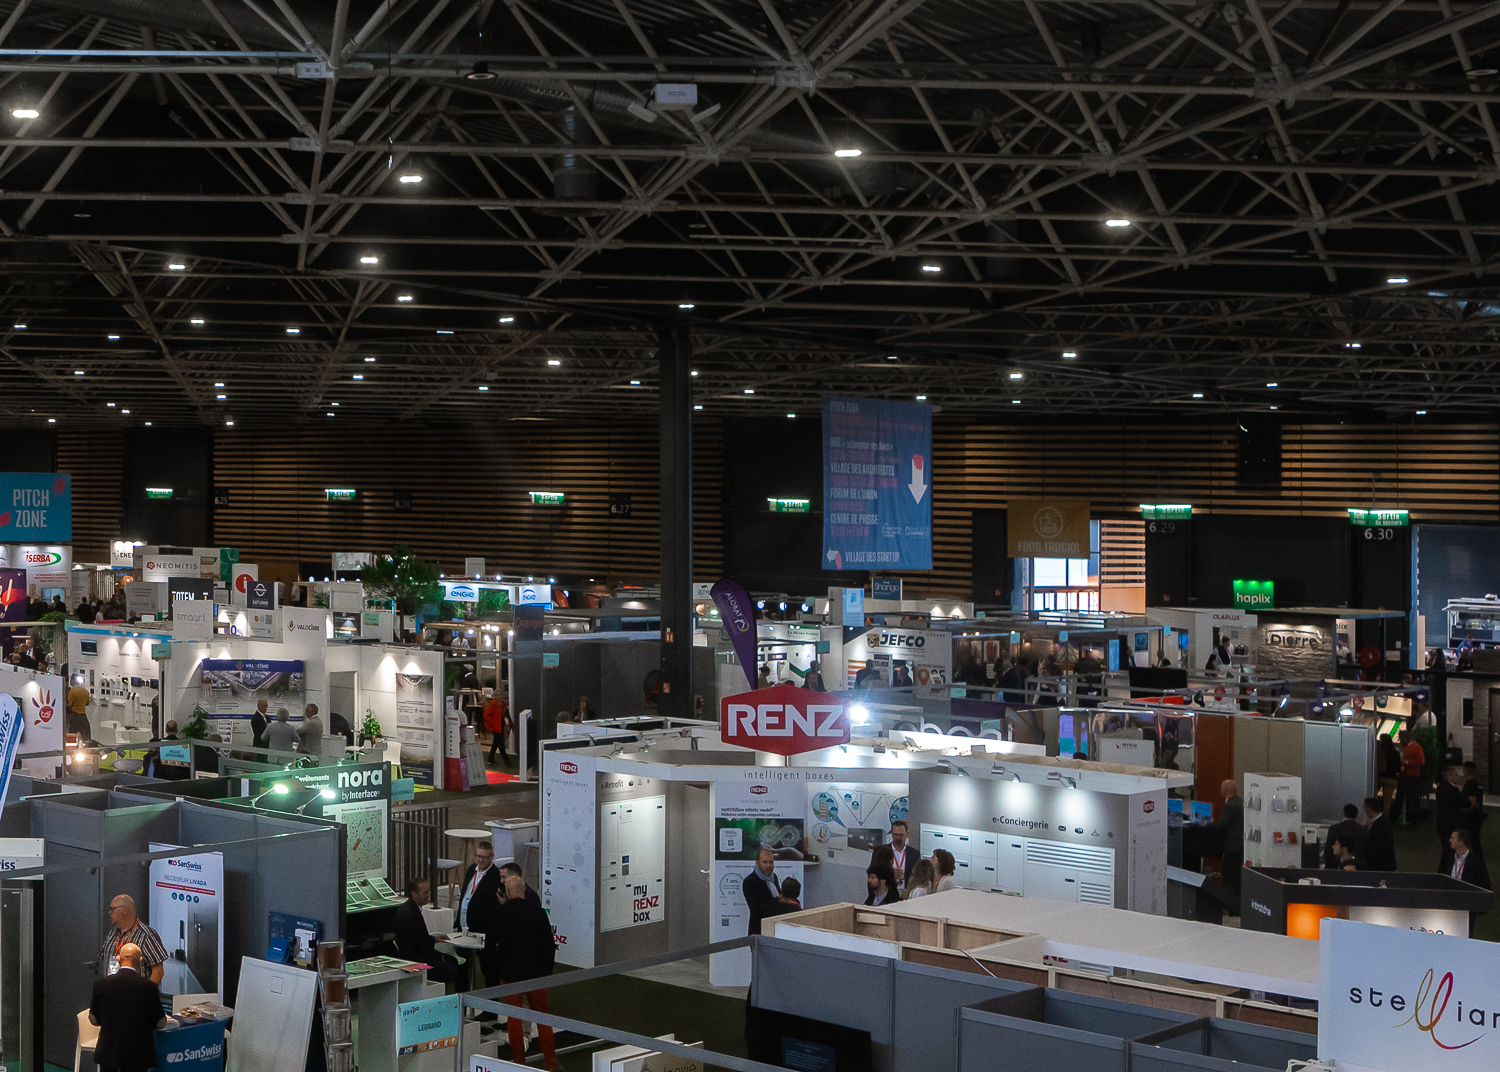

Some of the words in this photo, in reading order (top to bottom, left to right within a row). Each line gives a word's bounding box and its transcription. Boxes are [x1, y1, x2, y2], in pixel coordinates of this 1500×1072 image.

[831, 462, 851, 473] VILLAGE
[12, 489, 50, 507] PITCH
[611, 504, 630, 514] 6.27
[15, 510, 48, 528] ZONE
[1149, 522, 1175, 534] 6.29
[1364, 528, 1394, 541] 6.30
[1017, 541, 1041, 552] FOOD
[1045, 541, 1080, 554] TRUCKS
[514, 617, 543, 631] Orange
[879, 633, 926, 648] JEFCO
[1270, 633, 1318, 646] Dierre
[727, 703, 844, 737] RENZ
[337, 767, 383, 788] nora
[744, 770, 800, 782] intelligent
[805, 771, 835, 780] boxes
[992, 815, 1049, 830] e-Conciergerie
[177, 860, 202, 870] SanSwiss
[164, 874, 189, 884] RECEVEUR
[633, 884, 648, 897] my
[633, 895, 659, 911] RENZ
[633, 911, 651, 923] box
[418, 1021, 442, 1032] LEGRAND
[184, 1043, 222, 1061] SanSwiss
